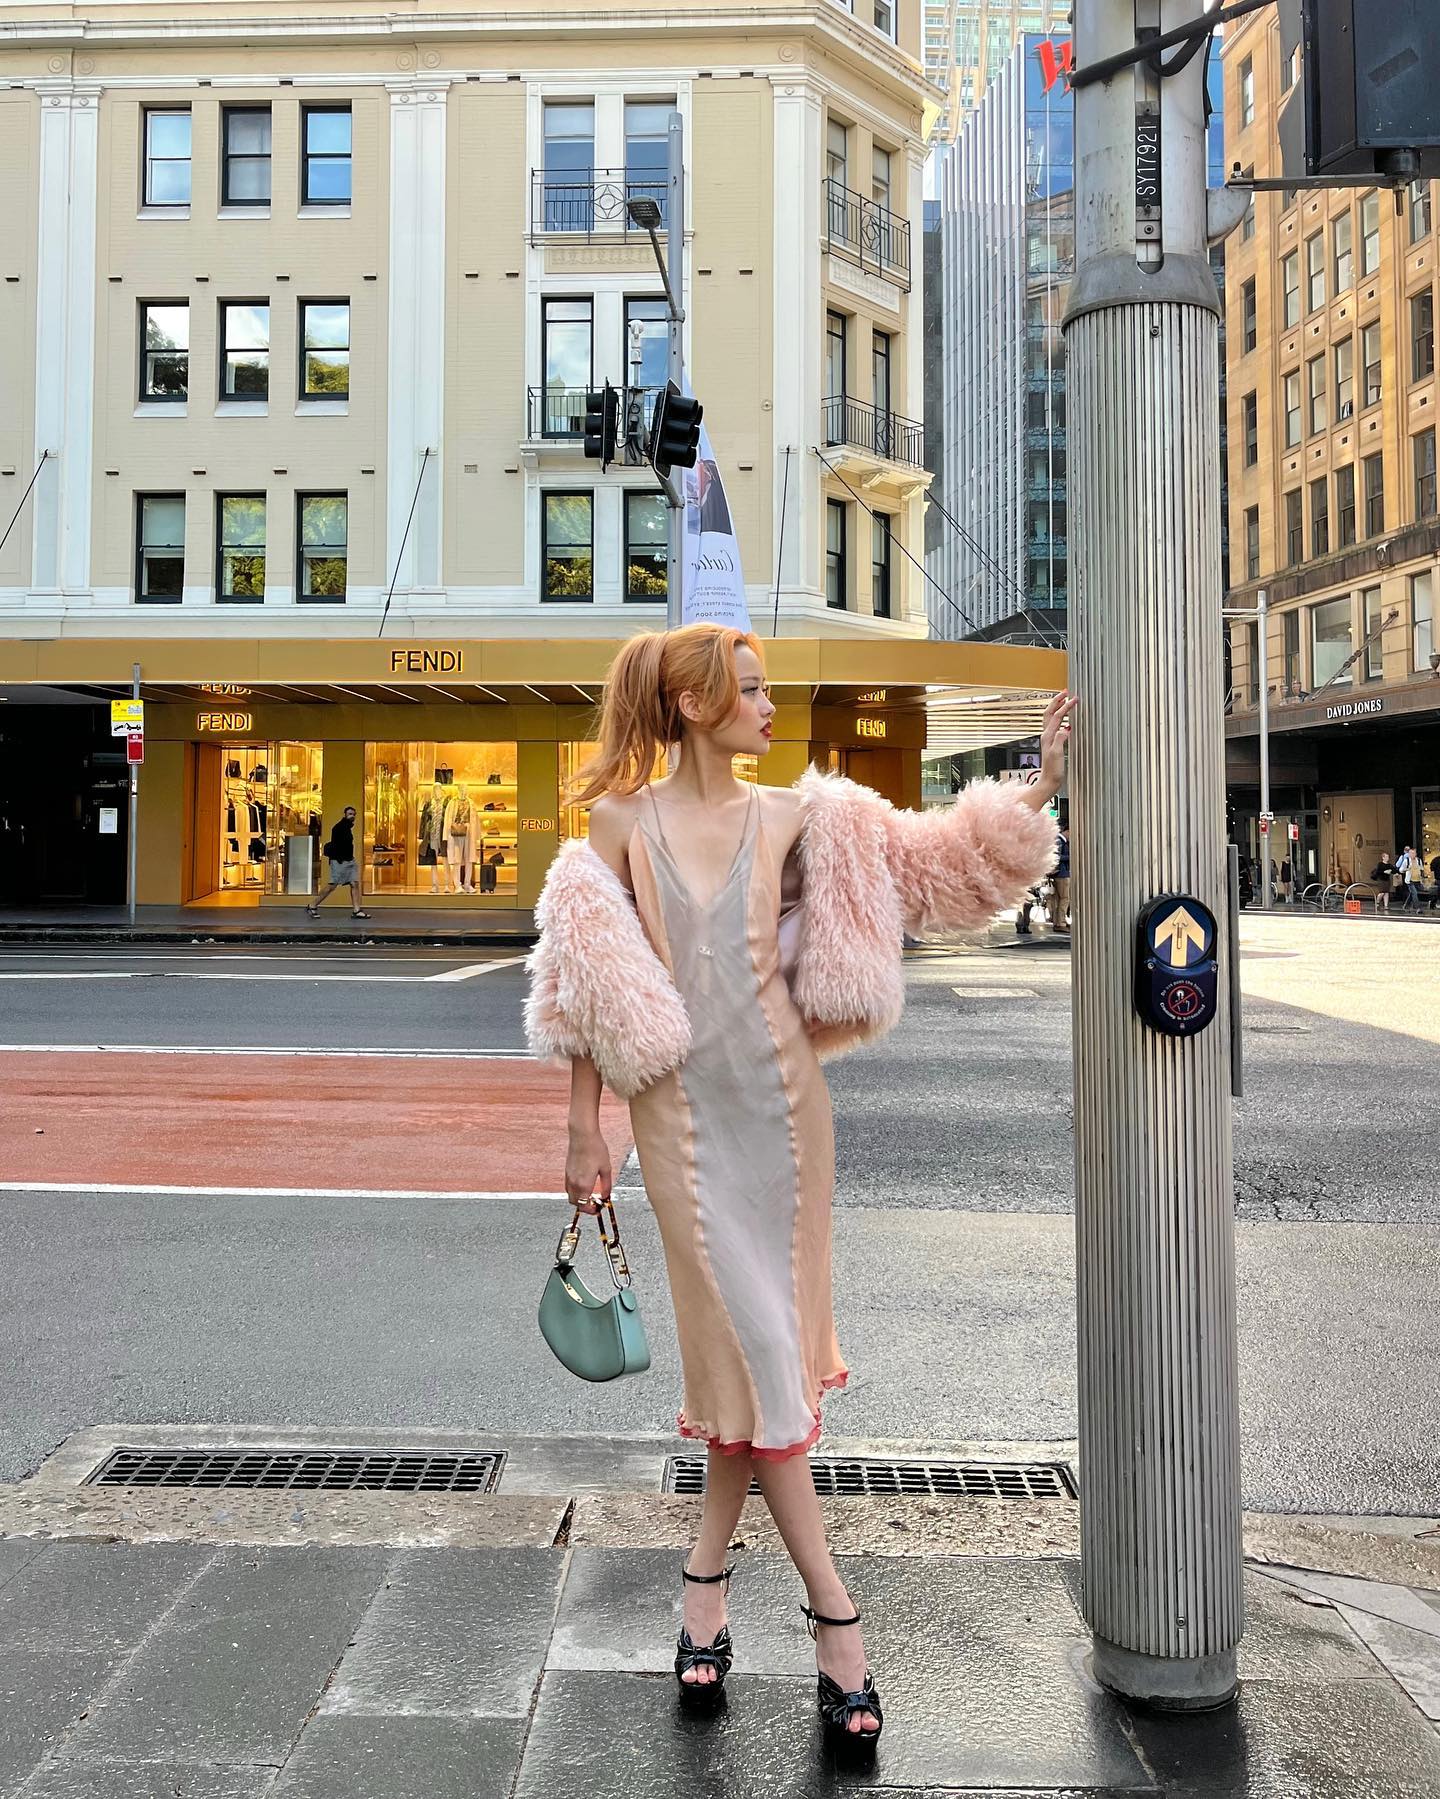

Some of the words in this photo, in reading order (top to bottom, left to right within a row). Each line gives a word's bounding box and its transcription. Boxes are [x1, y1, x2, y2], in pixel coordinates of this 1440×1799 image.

[1136, 125, 1157, 195] SY17921
[391, 650, 463, 673] FENDI
[1326, 704, 1353, 719] DAVID
[1353, 698, 1382, 715] JONES
[198, 713, 252, 731] FENDI
[857, 718, 886, 738] FENDI
[521, 819, 554, 831] FENDI
